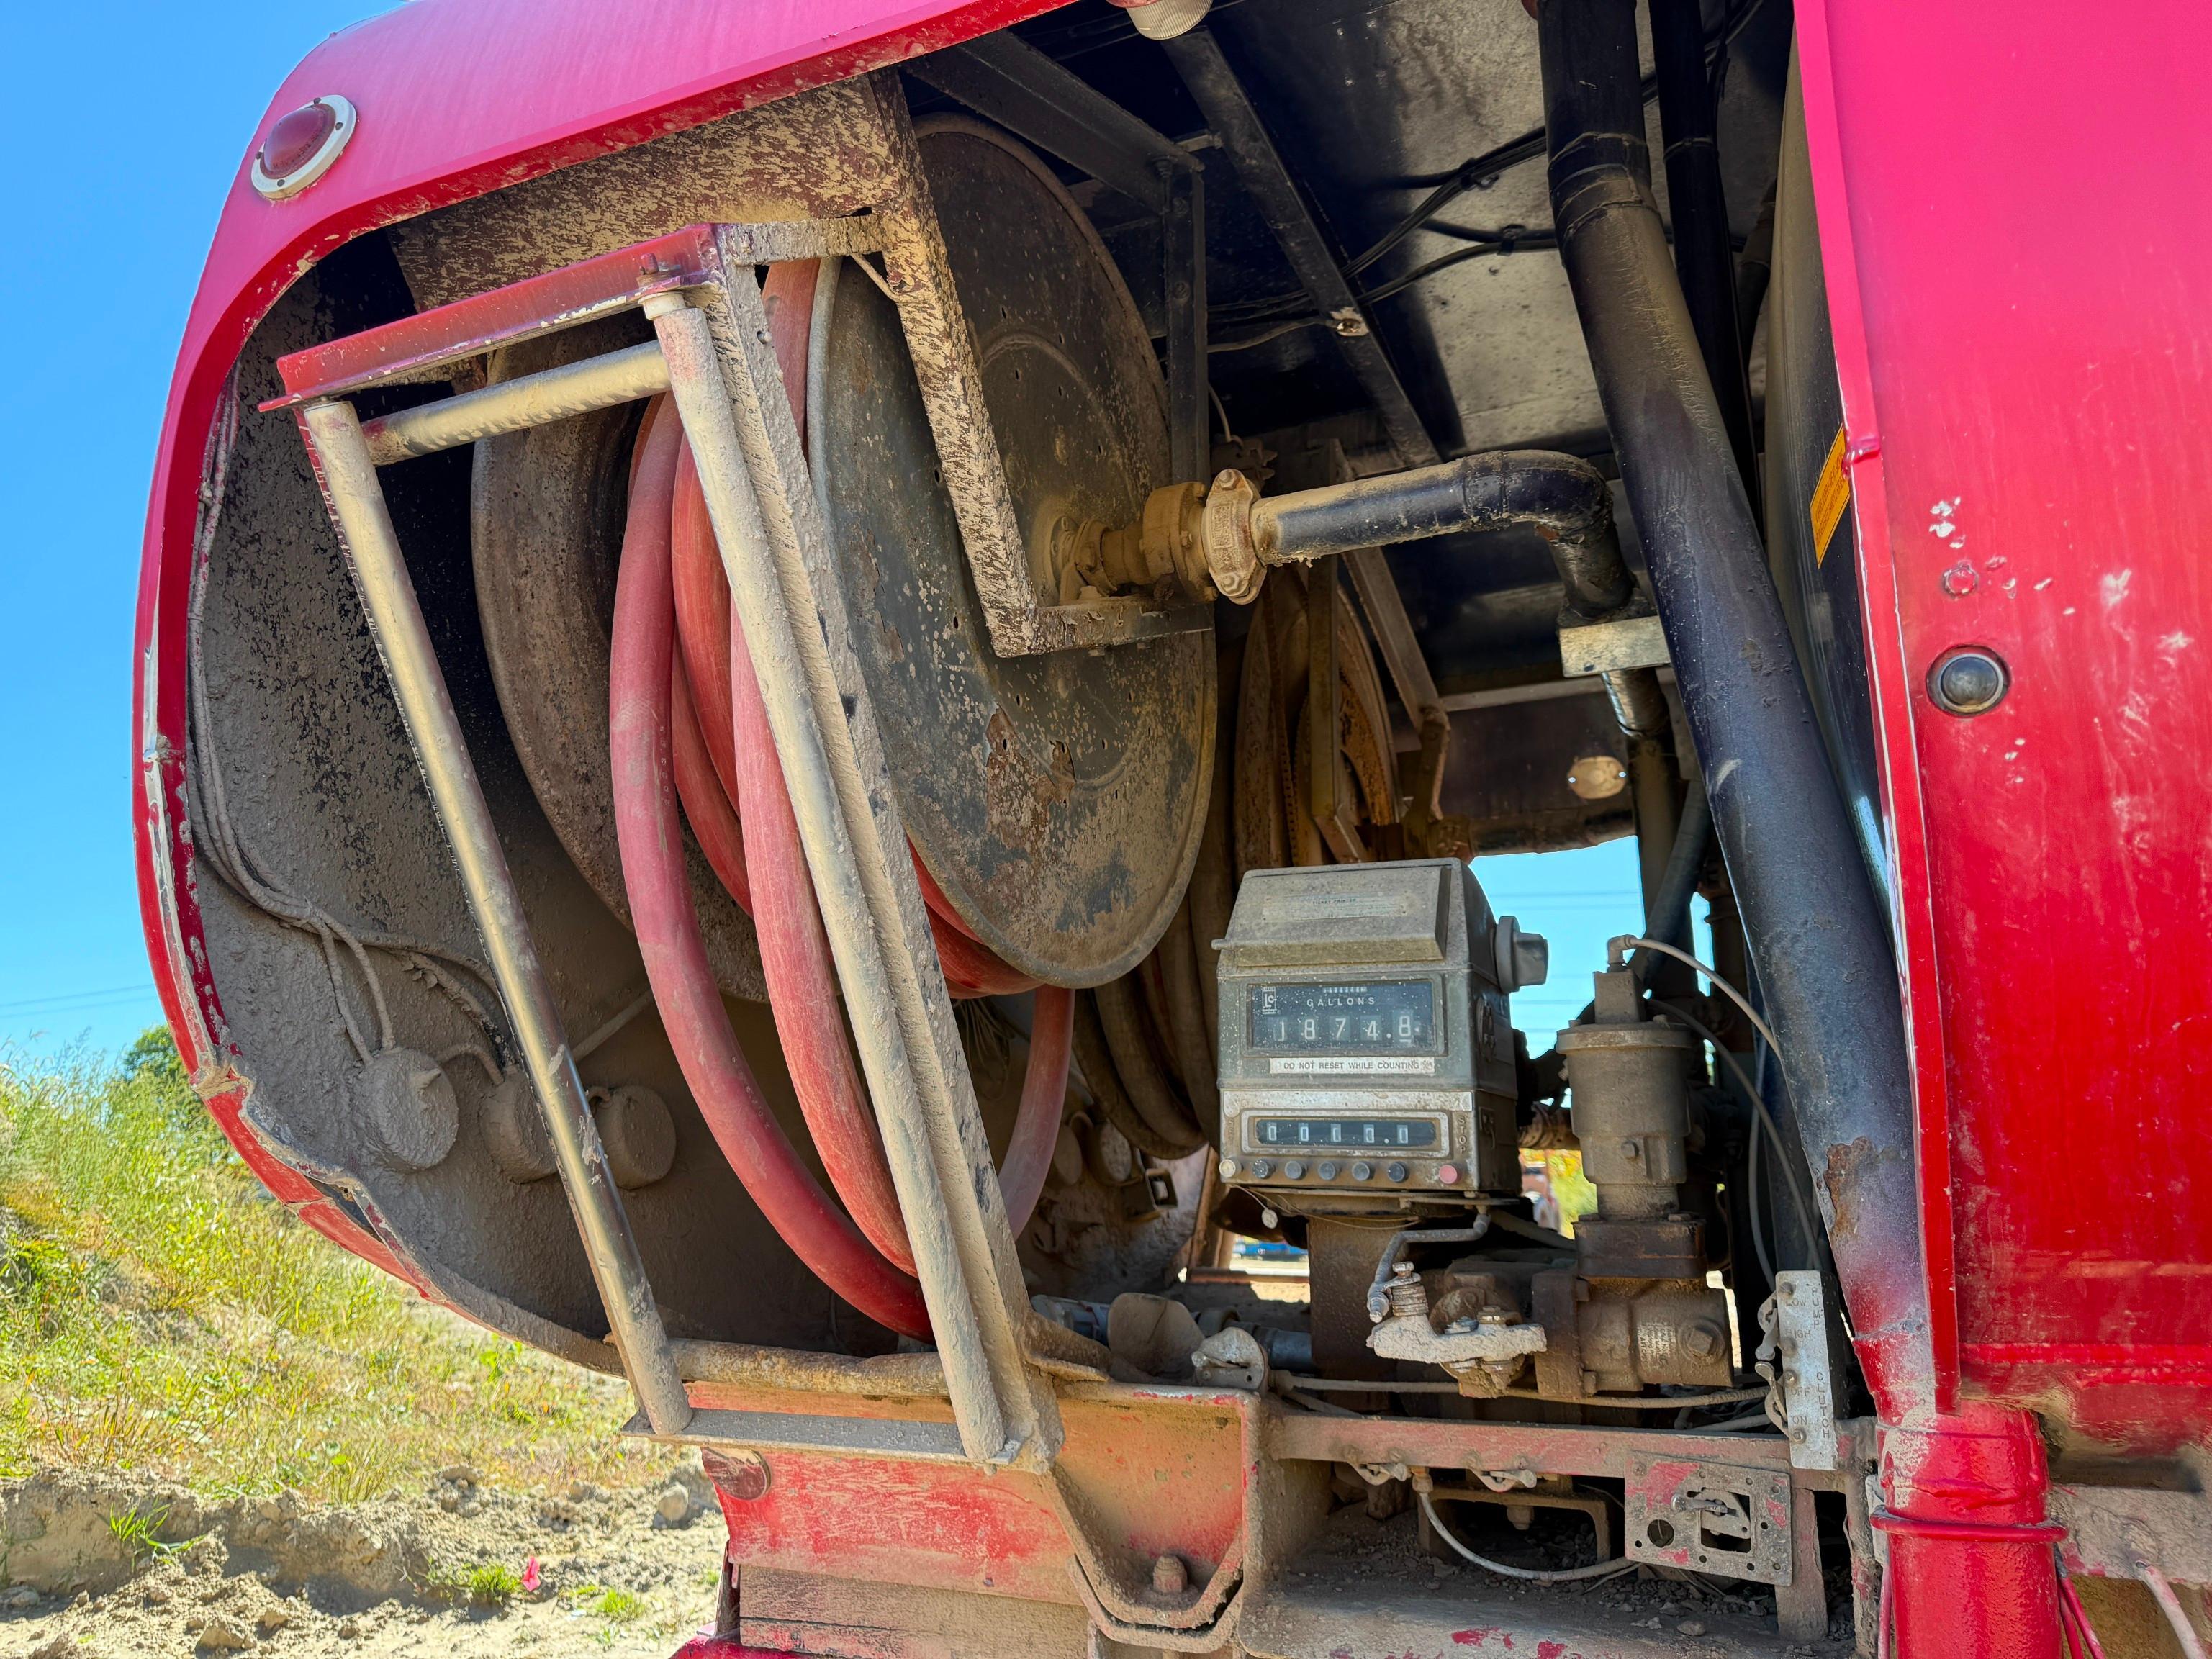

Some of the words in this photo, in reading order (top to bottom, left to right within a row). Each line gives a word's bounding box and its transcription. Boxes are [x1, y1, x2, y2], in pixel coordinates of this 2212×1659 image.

[1306, 997, 1376, 1007] GALLONS
[1377, 1060, 1419, 1070] COUNTING
[1458, 1116, 1467, 1154] STOP
[1785, 1297, 1807, 1308] LOW
[1816, 1371, 1830, 1439] CLUTCH
[1792, 1415, 1807, 1426] ON
